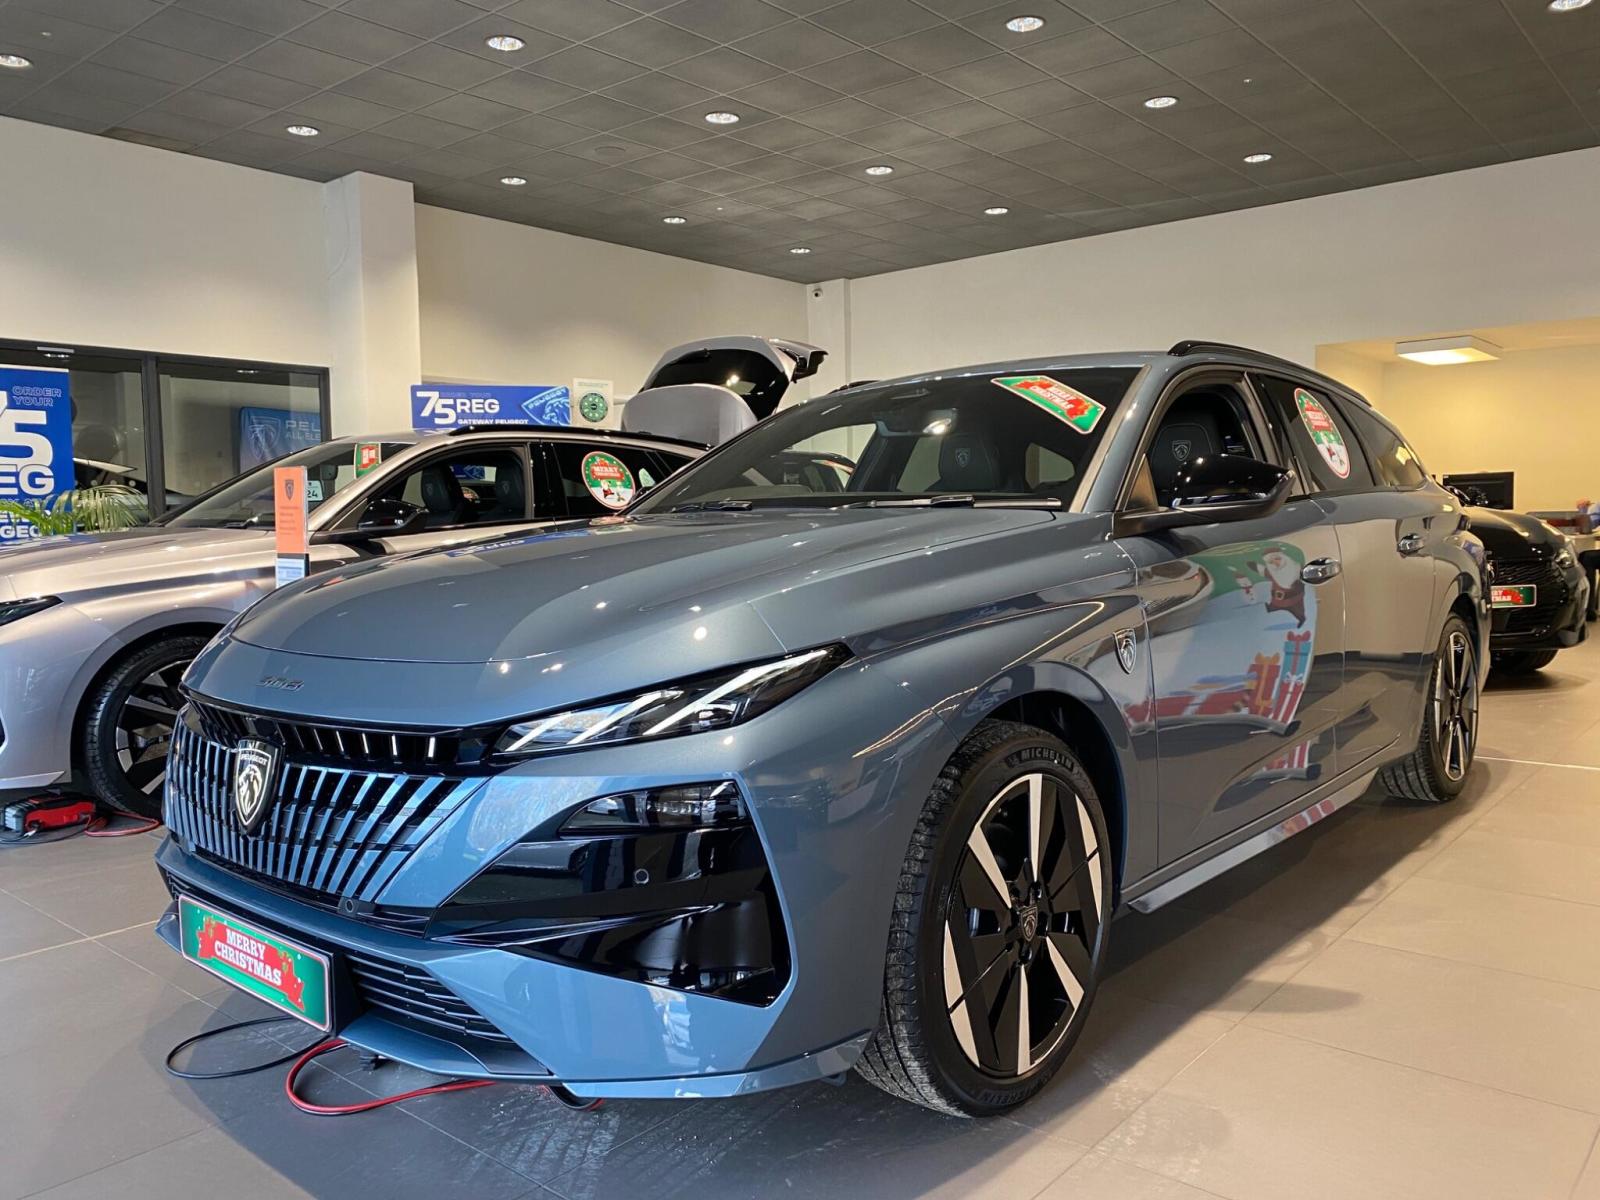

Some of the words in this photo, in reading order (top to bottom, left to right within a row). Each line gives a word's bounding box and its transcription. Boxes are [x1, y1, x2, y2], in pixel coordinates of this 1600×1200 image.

[12, 385, 62, 397] ORDER
[12, 395, 54, 407] YOUR
[416, 391, 457, 425] 75
[456, 398, 500, 414] REG
[0, 390, 53, 467] 5
[240, 752, 269, 767] PEUGEOT
[1021, 748, 1073, 767] MICHELIN
[226, 928, 266, 961] MERRY
[214, 940, 282, 986] CHRISTMAS
